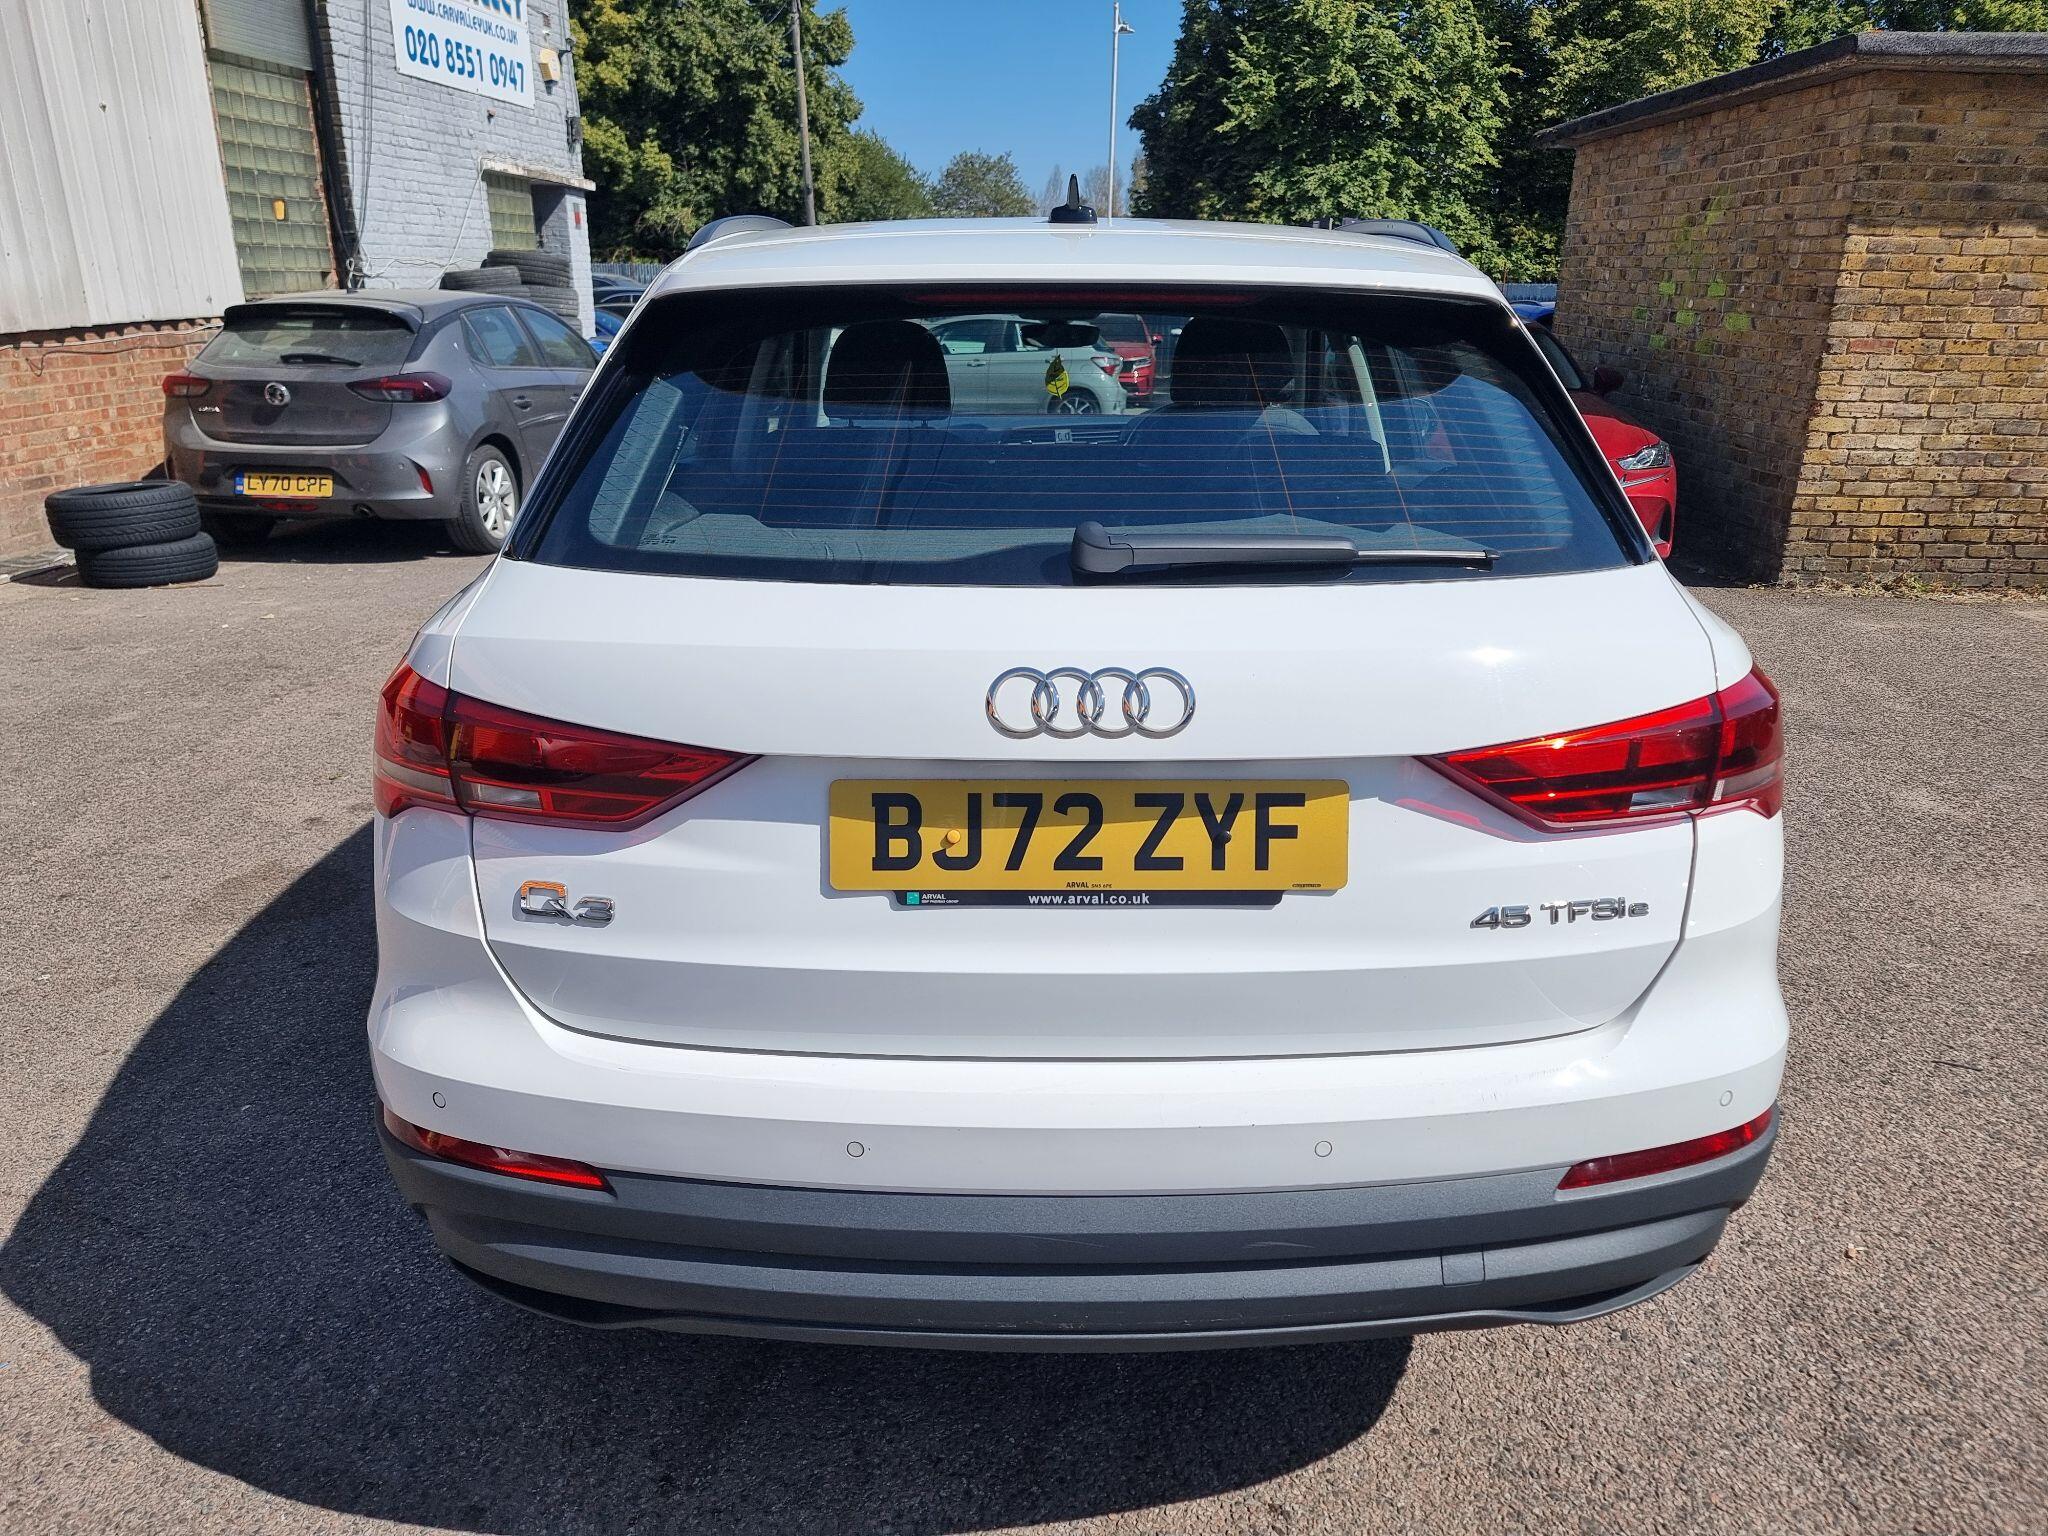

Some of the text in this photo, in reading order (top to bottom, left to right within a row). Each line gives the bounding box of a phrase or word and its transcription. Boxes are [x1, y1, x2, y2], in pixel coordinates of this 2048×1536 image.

[405, 25, 524, 93] 020 8551 0947
[247, 475, 328, 492] LY70 CPF
[871, 792, 1306, 871] BJ72 ZYF
[1028, 892, 1150, 904] www.arval.co.uk
[1066, 881, 1089, 889] ARVAL
[520, 879, 615, 922] Q3
[1469, 904, 1532, 931] 45
